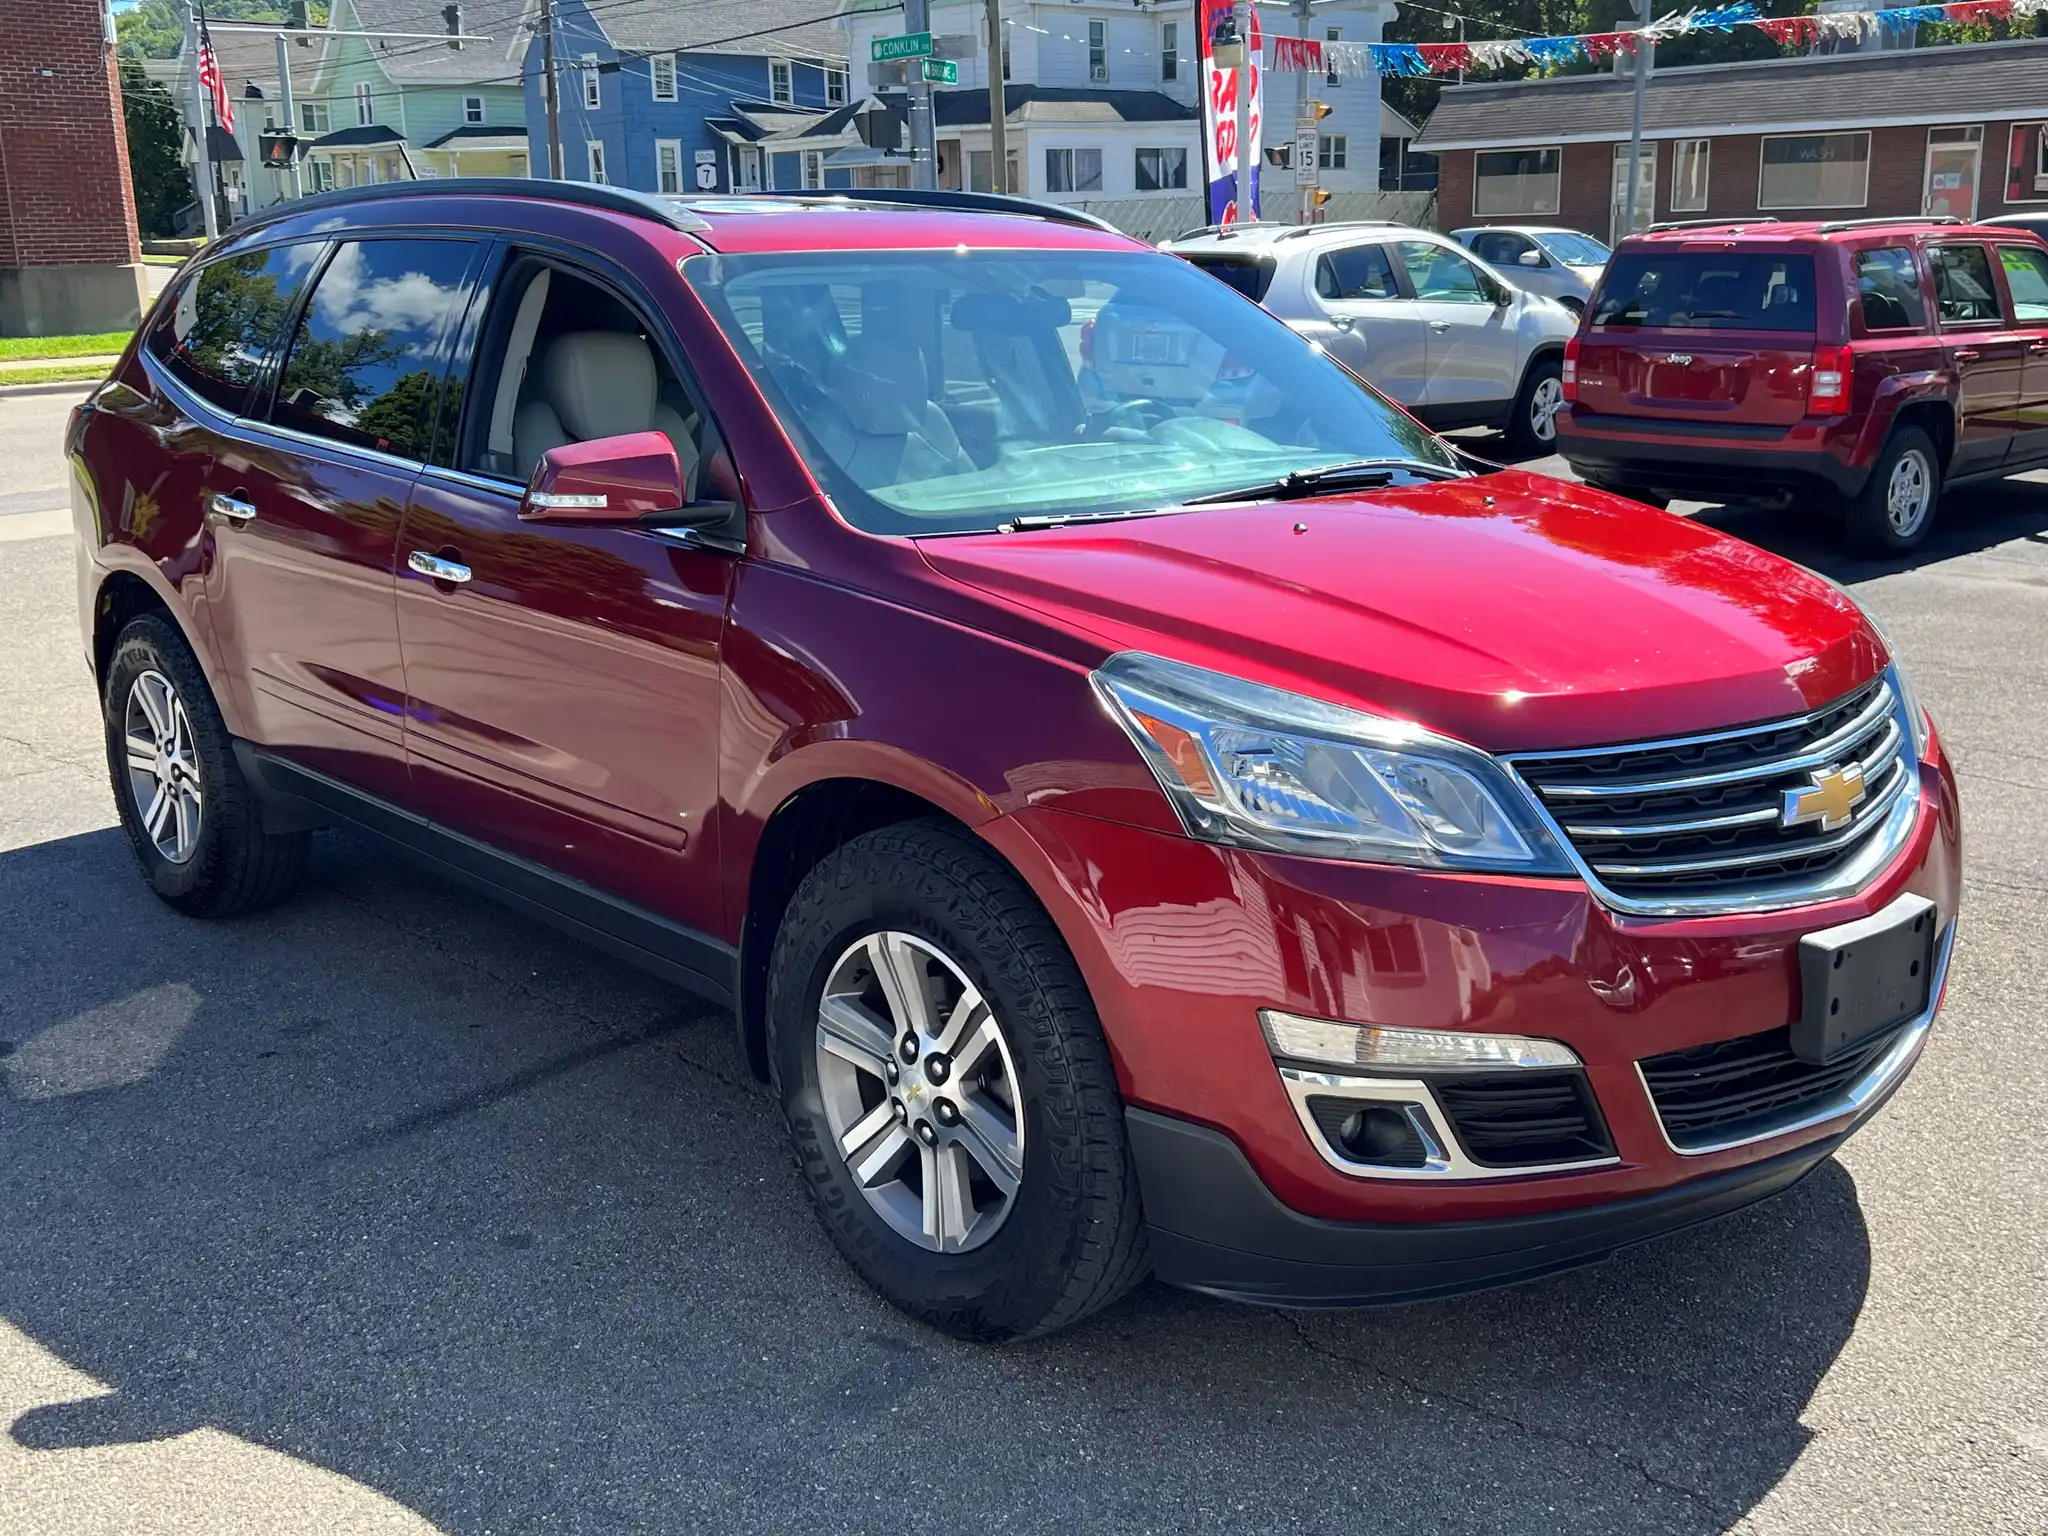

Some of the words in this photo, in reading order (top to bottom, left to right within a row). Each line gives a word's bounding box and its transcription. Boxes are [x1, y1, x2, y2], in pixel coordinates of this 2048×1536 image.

[883, 39, 919, 56] CONKLIN
[1298, 133, 1315, 141] SPEED
[1299, 141, 1314, 149] LIMIT
[1300, 151, 1314, 167] 15
[703, 169, 710, 183] 7
[1666, 353, 1692, 366] Jeep
